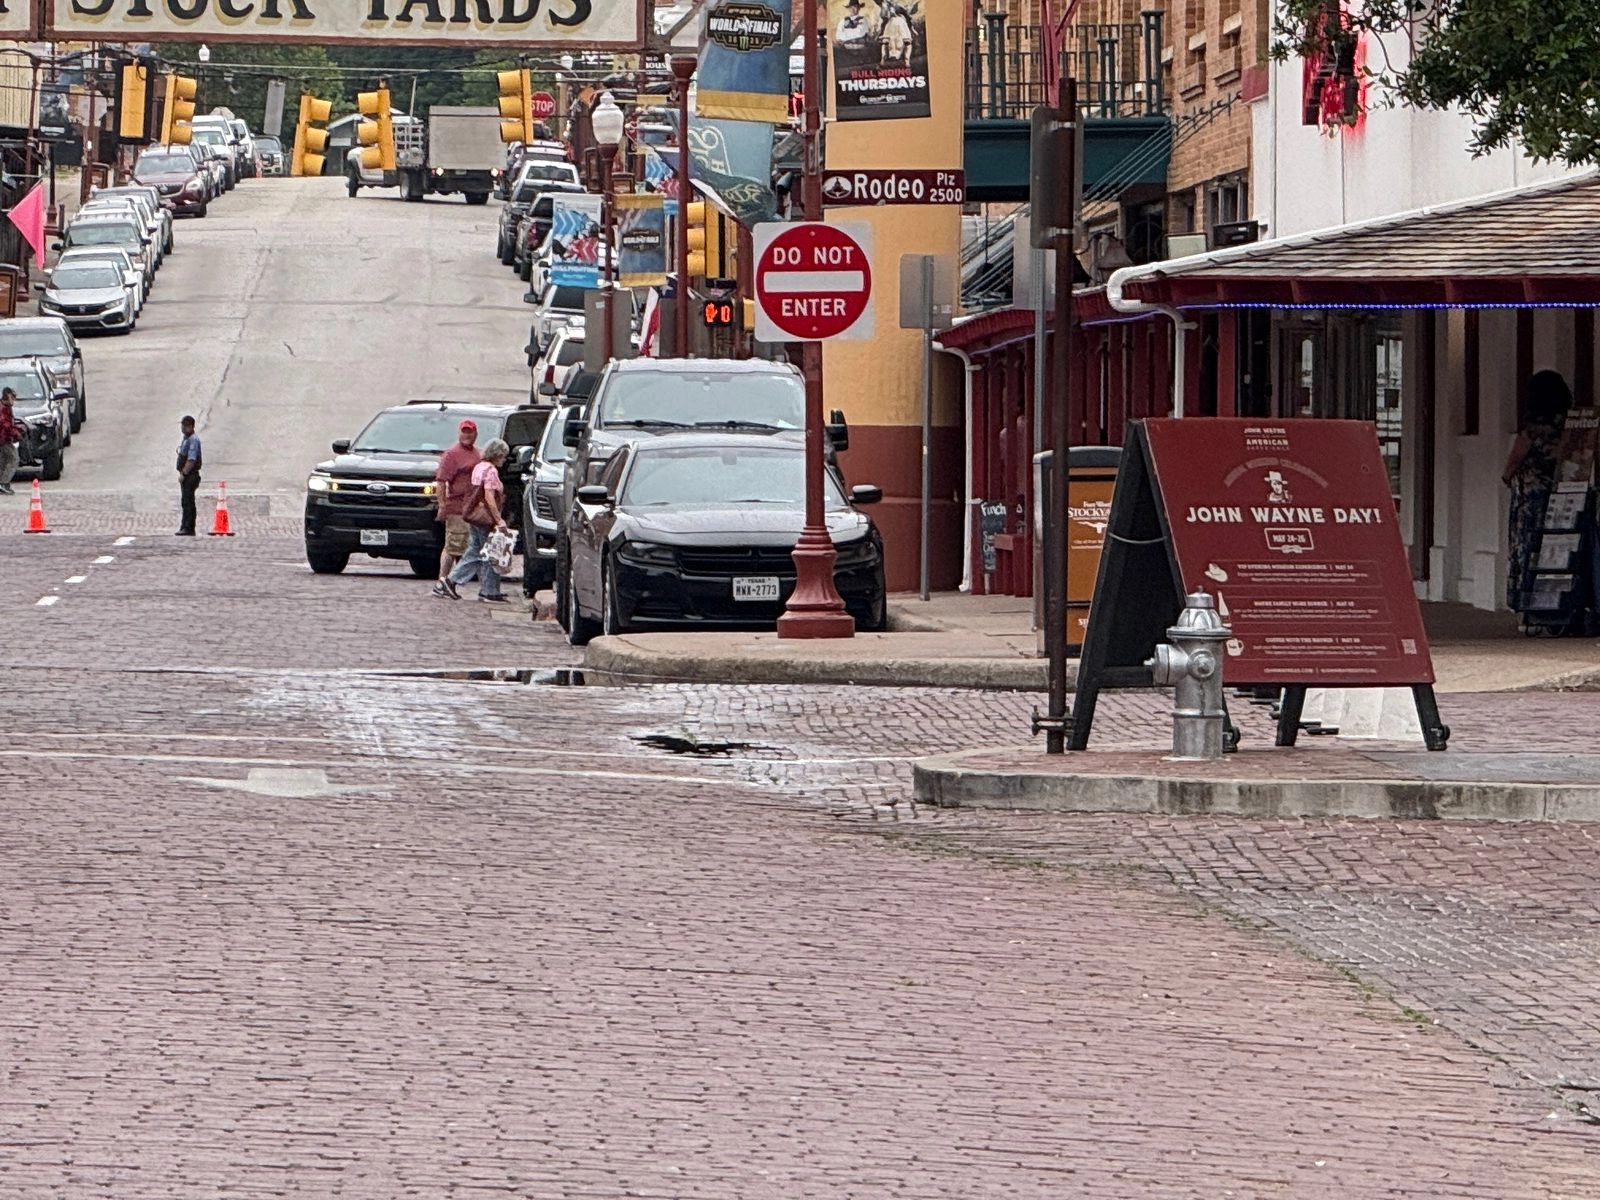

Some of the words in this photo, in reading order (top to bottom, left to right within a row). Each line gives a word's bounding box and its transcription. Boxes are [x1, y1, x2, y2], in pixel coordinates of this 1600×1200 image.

[709, 17, 741, 31] WORLD
[748, 20, 780, 34] FINALS
[850, 69, 876, 79] BULL
[878, 68, 912, 77] RIDING
[838, 75, 927, 92] THURSDAYS
[531, 101, 554, 112] STOP
[853, 172, 925, 200] Rodeo
[936, 171, 956, 187] Plz
[929, 187, 963, 203] 2500
[773, 246, 801, 265] DO
[813, 246, 855, 265] NOT
[781, 298, 847, 317] ENTER
[1246, 438, 1289, 446] AMERICAN
[1068, 506, 1111, 518] STOCKYA
[1186, 506, 1243, 523] JOHN
[1249, 506, 1326, 524] WAYNE
[1332, 507, 1383, 525] DAY!
[1272, 534, 1286, 543] MAY
